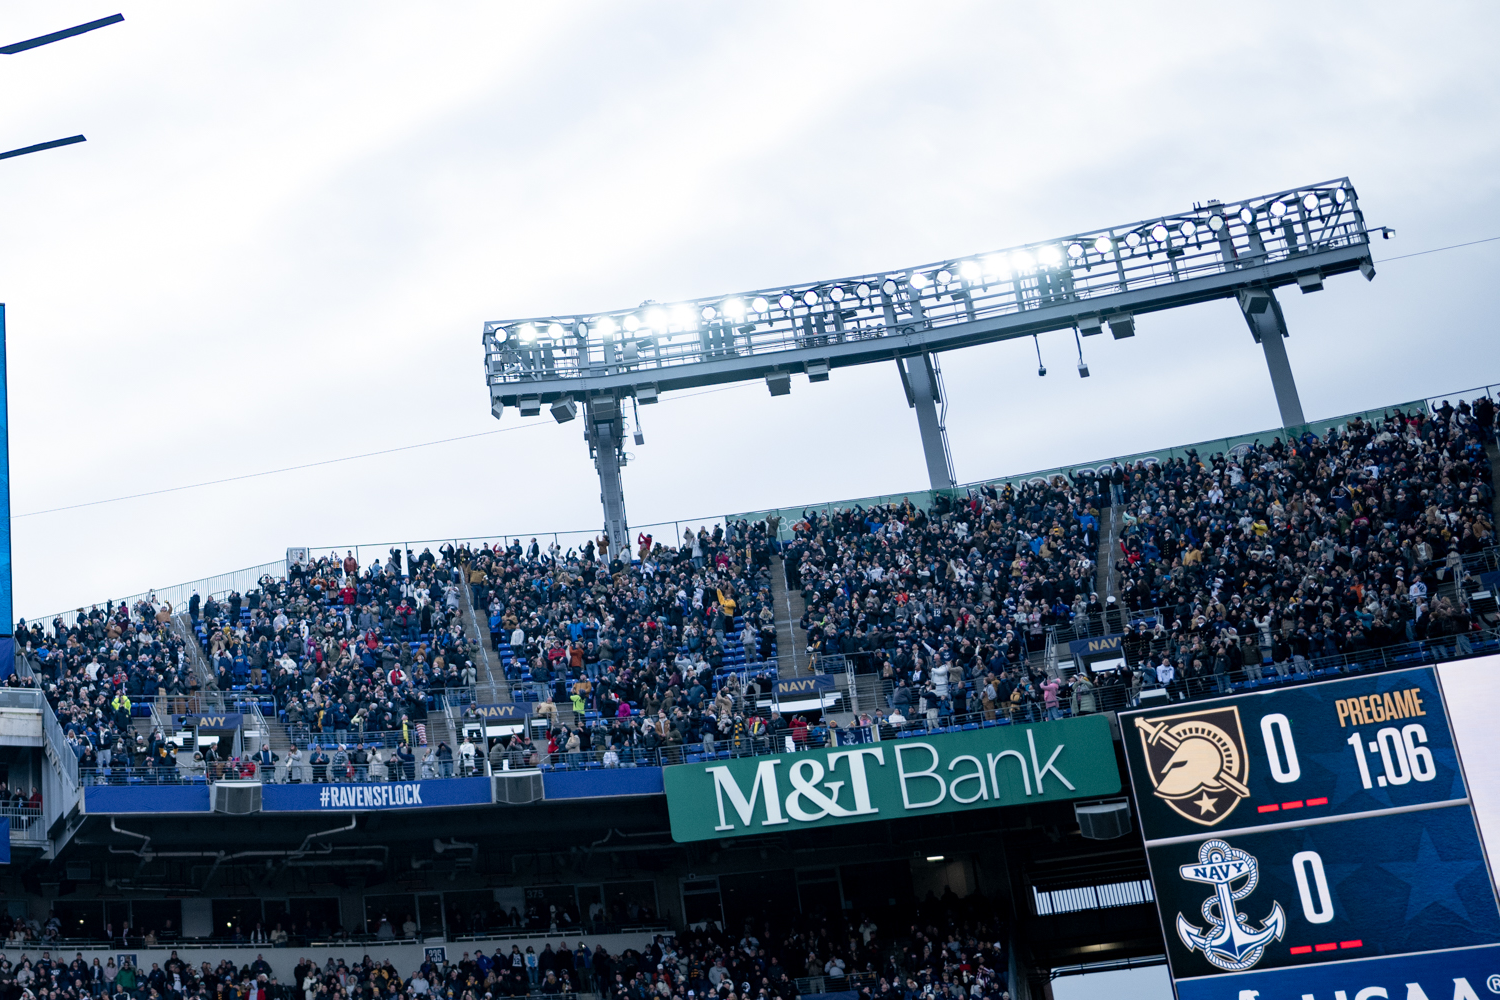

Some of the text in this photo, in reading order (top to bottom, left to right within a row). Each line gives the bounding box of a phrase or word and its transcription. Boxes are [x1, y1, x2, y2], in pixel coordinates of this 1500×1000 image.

[778, 679, 816, 693] NAVY
[480, 706, 515, 717] NAVY
[1335, 688, 1427, 728] PREGAME
[200, 716, 226, 727] AVY
[1260, 713, 1301, 784] 0
[1347, 723, 1437, 789] 1:06
[705, 728, 1076, 831] M&T Bank
[320, 783, 422, 807] #RAVENSFLOCK
[1193, 861, 1244, 881] NAVY
[526, 888, 544, 899] 375
[1292, 850, 1335, 924] 0
